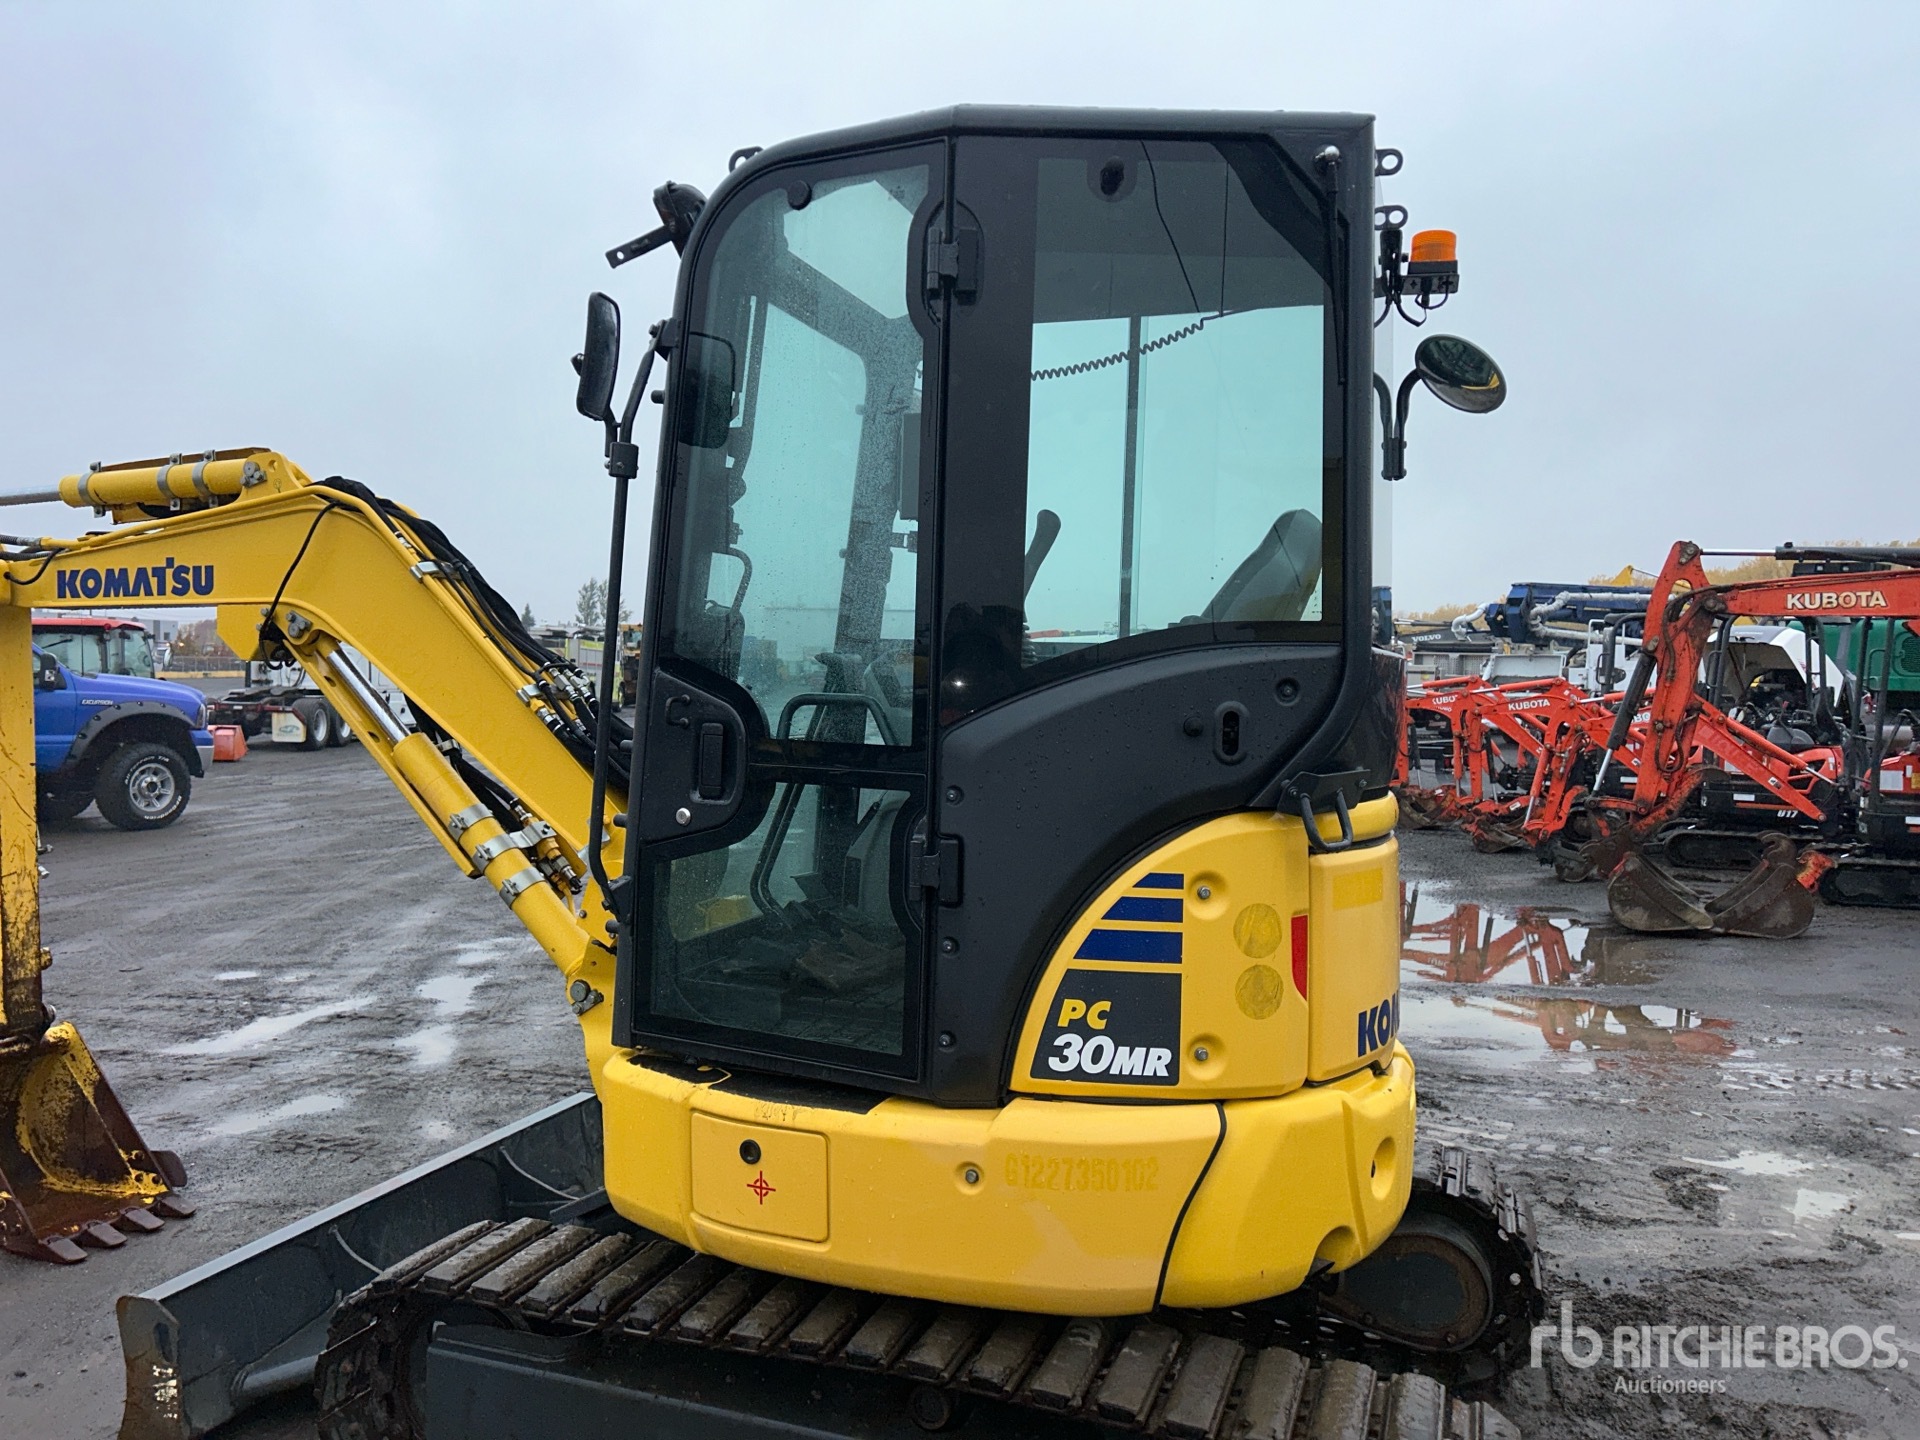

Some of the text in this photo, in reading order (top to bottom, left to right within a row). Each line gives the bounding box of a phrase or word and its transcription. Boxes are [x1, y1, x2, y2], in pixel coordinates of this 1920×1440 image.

[57, 557, 214, 599] KOMATSU
[1786, 590, 1888, 610] KUBOTA
[1411, 633, 1442, 643] VOLVO
[1508, 698, 1550, 711] KUBOTA
[1777, 809, 1798, 818] U17
[1057, 998, 1112, 1030] PC
[1048, 1033, 1172, 1077] 30MR
